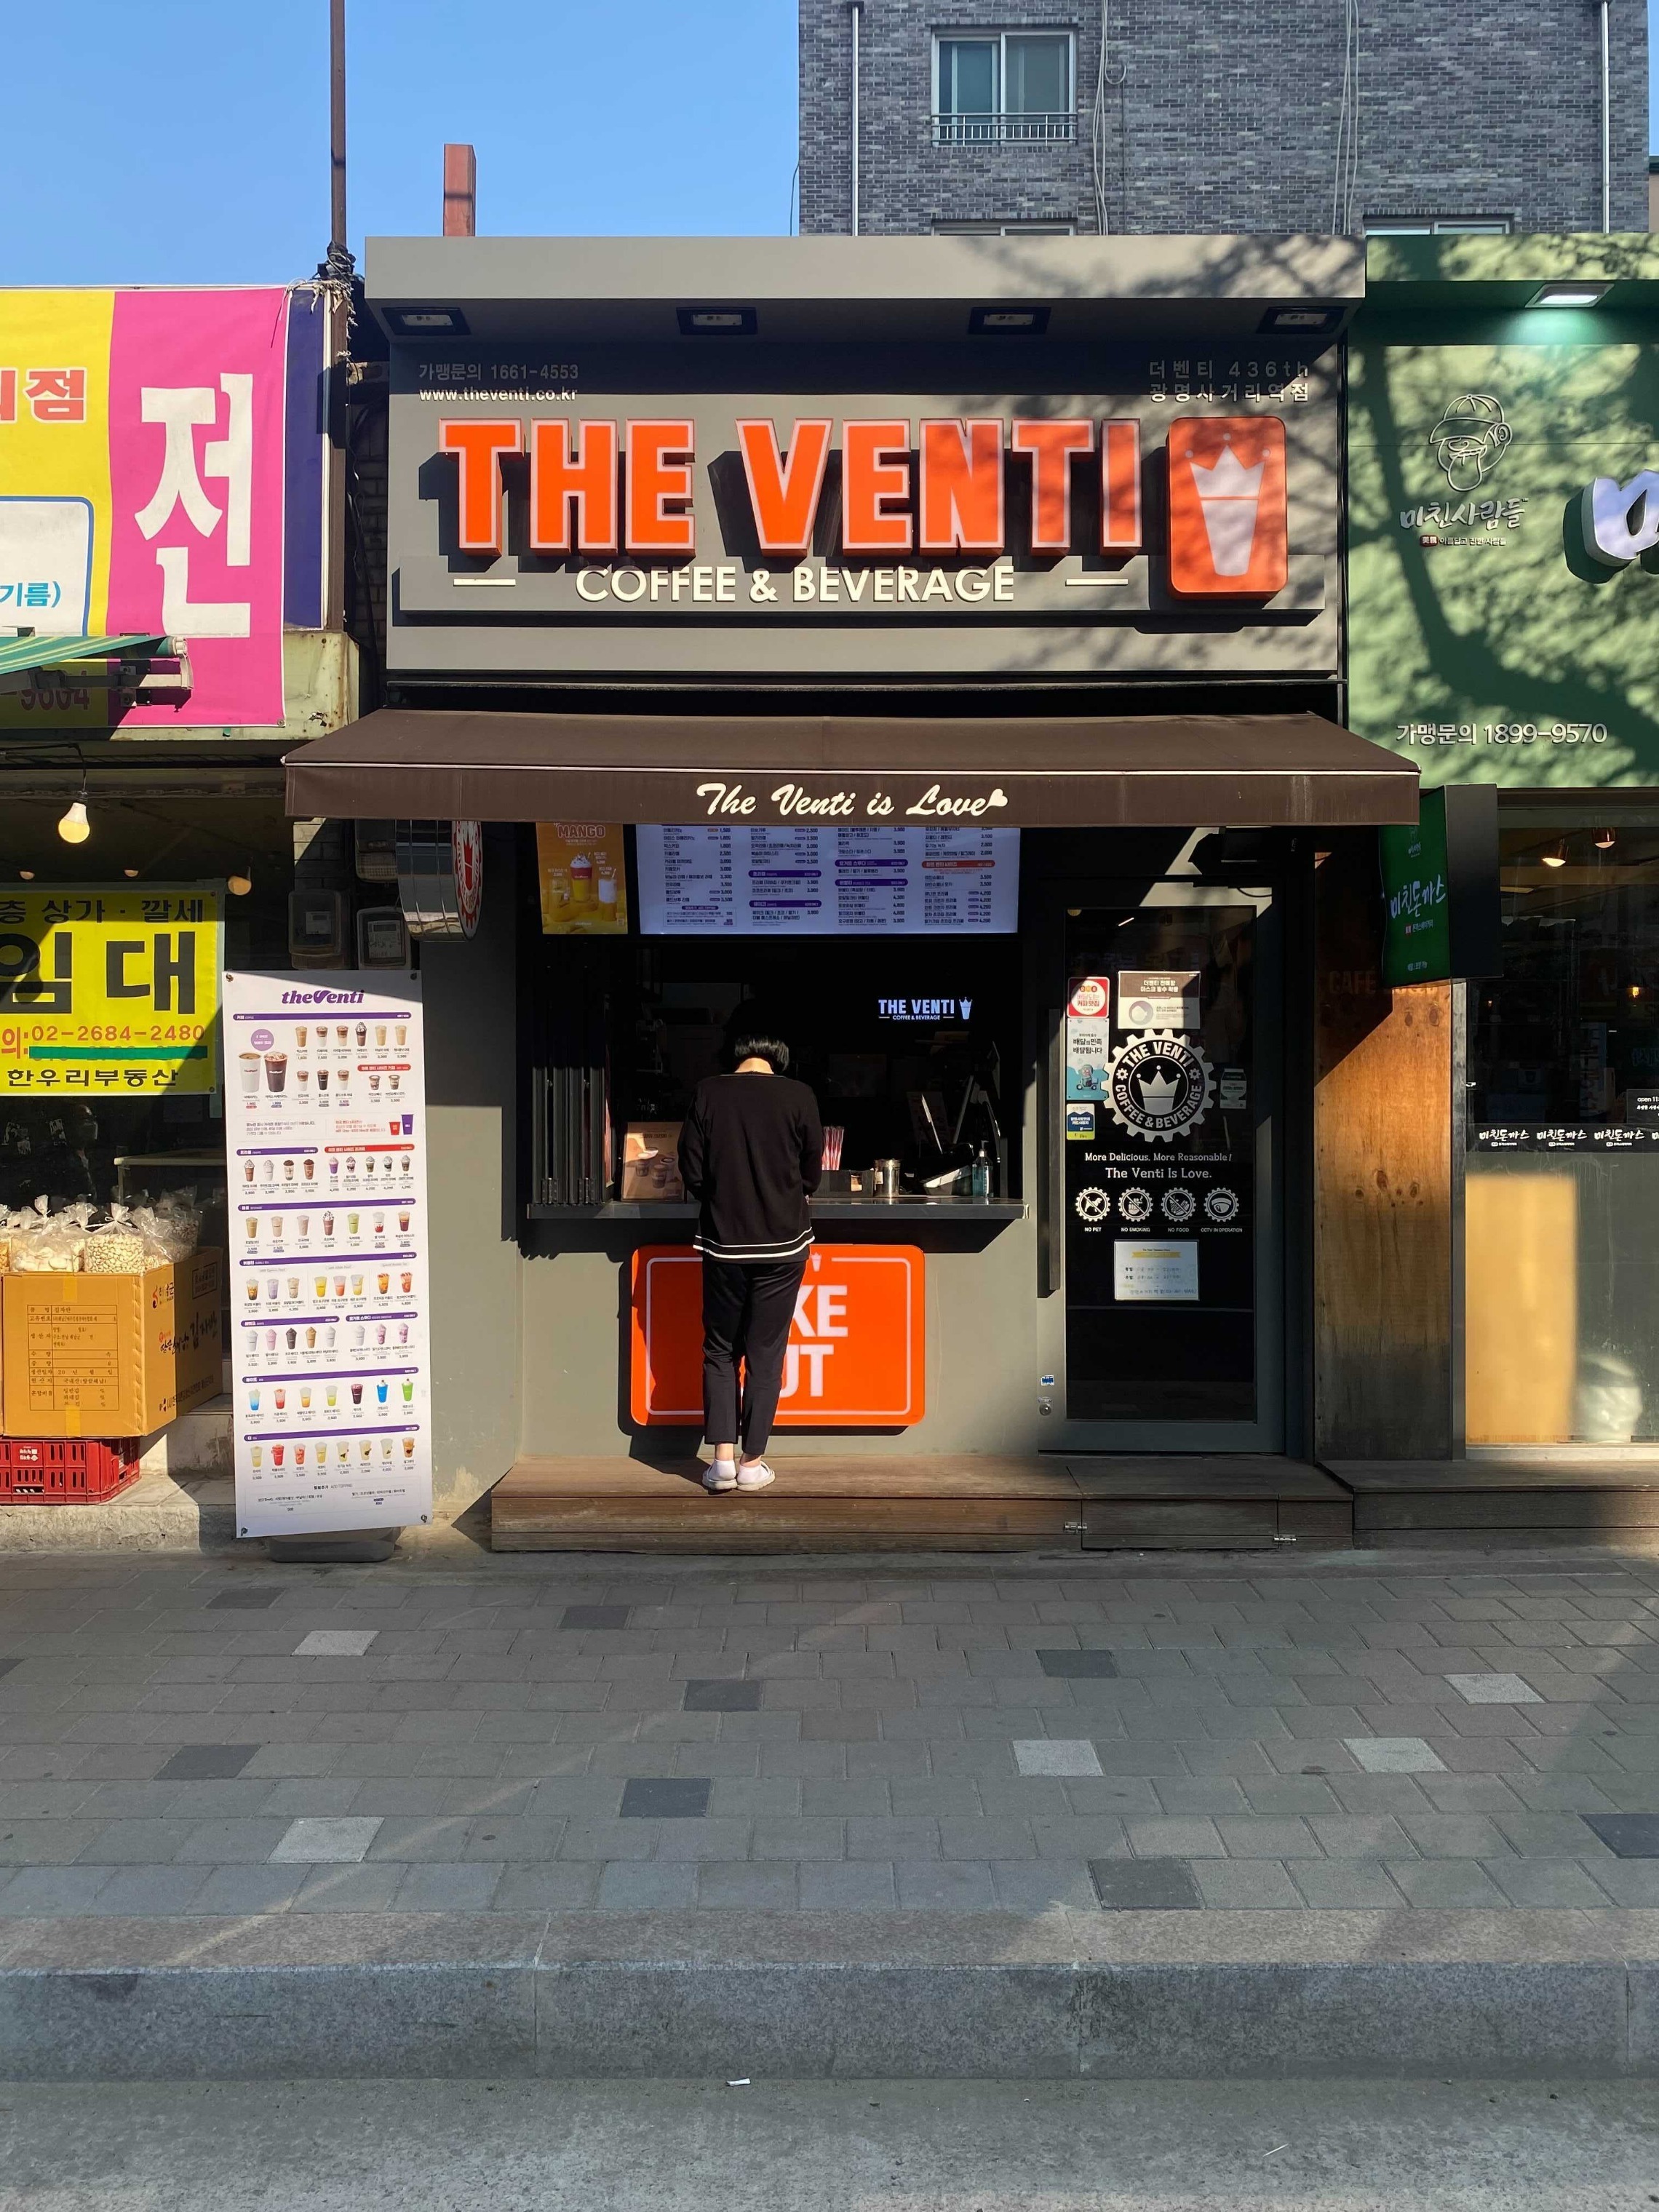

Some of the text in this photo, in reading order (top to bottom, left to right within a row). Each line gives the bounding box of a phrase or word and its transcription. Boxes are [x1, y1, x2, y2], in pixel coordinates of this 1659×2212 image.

[419, 363, 579, 381] 가맹문의 1661-4553
[419, 386, 578, 402] www.theventi.co.kr
[1149, 383, 1308, 402] 광명사거리역점
[439, 418, 1142, 554] THE VENTI
[135, 373, 254, 638] 전
[1400, 498, 1525, 530] 미친사람들
[576, 565, 1014, 602] COFFEE & BEVERAGE
[1396, 723, 1608, 744] 가맹문의 1899-9570
[696, 782, 990, 816] The Venti is Love
[557, 824, 606, 838] MANGO
[1390, 873, 1446, 918] 미친돈까스
[41, 899, 106, 924] 상가
[142, 899, 204, 923] 깔세
[878, 999, 955, 1014] THE VENTI
[31, 1025, 205, 1041] 02-2684-2480
[1122, 1041, 1194, 1067] THE VENTI
[7, 1069, 179, 1087] 한우리부동산
[1115, 1084, 1145, 1124] COFFEE
[1145, 1116, 1154, 1128] &
[1155, 1085, 1201, 1129] BEVERAGE
[1084, 1153, 1107, 1161] More
[1153, 1153, 1175, 1161] More
[1178, 1153, 1232, 1161] Reasonable!
[1105, 1167, 1212, 1178] The Venti Is Love.
[788, 1285, 848, 1337] KE
